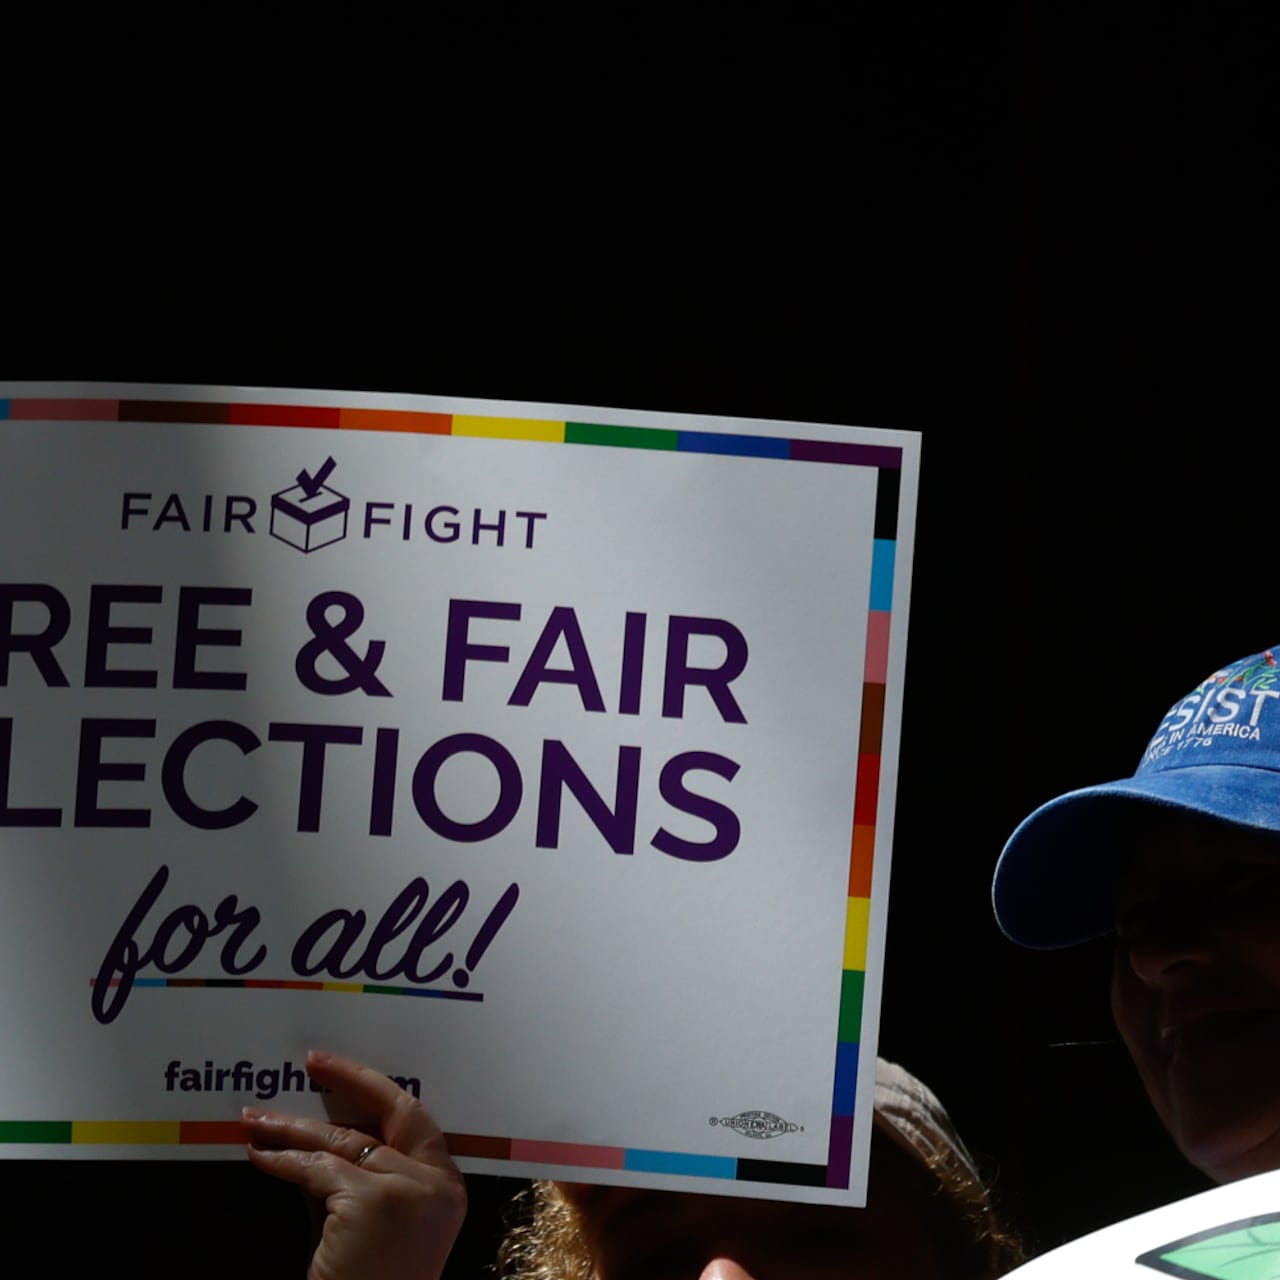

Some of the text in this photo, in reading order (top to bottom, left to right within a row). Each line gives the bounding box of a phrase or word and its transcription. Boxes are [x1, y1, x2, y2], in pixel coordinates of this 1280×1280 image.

[121, 492, 548, 549] FAIR FIGHT
[294, 590, 394, 698] &
[441, 598, 749, 725] FAIR
[1186, 722, 1261, 742] AMERICA
[92, 865, 520, 1024] for all!
[164, 1060, 421, 1100] fairfight.m
